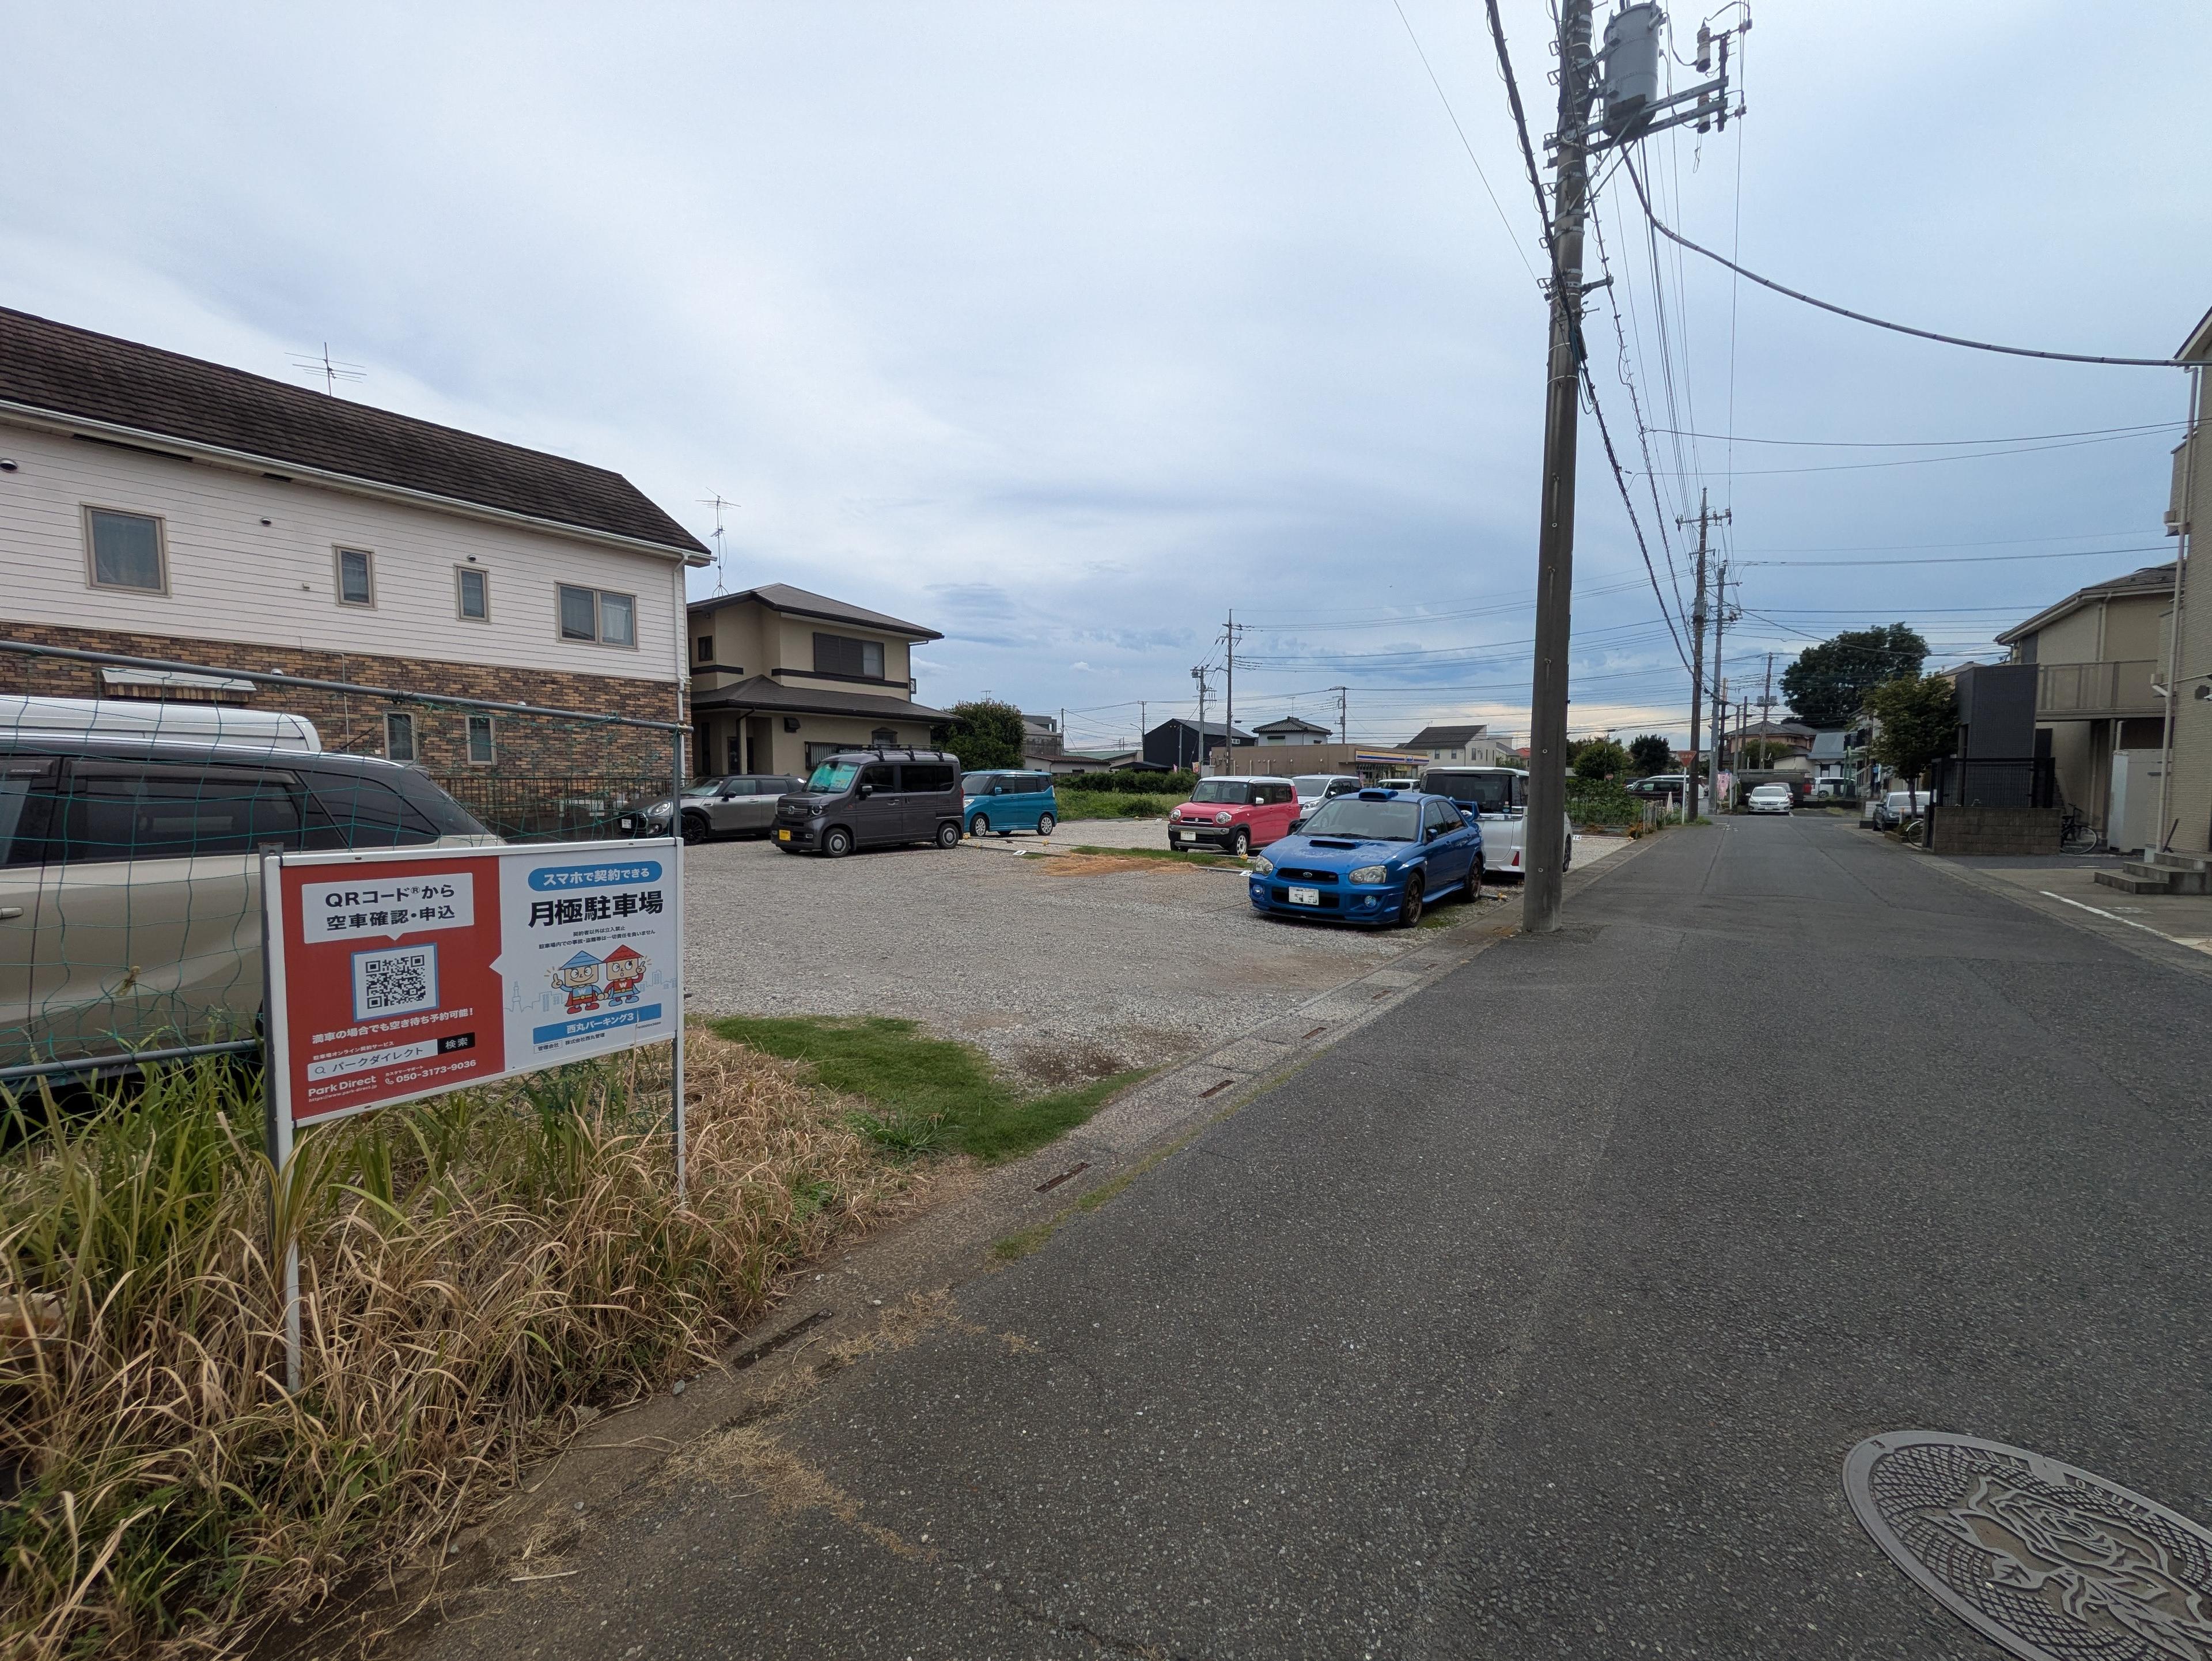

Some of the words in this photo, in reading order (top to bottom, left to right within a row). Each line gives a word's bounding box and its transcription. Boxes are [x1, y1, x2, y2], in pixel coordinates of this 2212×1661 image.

[543, 868, 650, 887] スマホで契約できる
[326, 905, 456, 931] 空車確認・申込
[528, 890, 664, 928] 月極駐車場
[573, 925, 626, 937] 契約者以外は立入禁止
[566, 1013, 634, 1035] 西丸パーキング3
[332, 1047, 424, 1073] パークダイレクト
[445, 1037, 468, 1050] 検索
[537, 1042, 560, 1052] 管理会社
[384, 1065, 424, 1077] カスタマーサポート
[395, 1059, 477, 1084] 050-3173-9036
[308, 1084, 338, 1097] Park
[339, 1075, 377, 1090] Direct
[2075, 1479, 2138, 1512] OSUI
